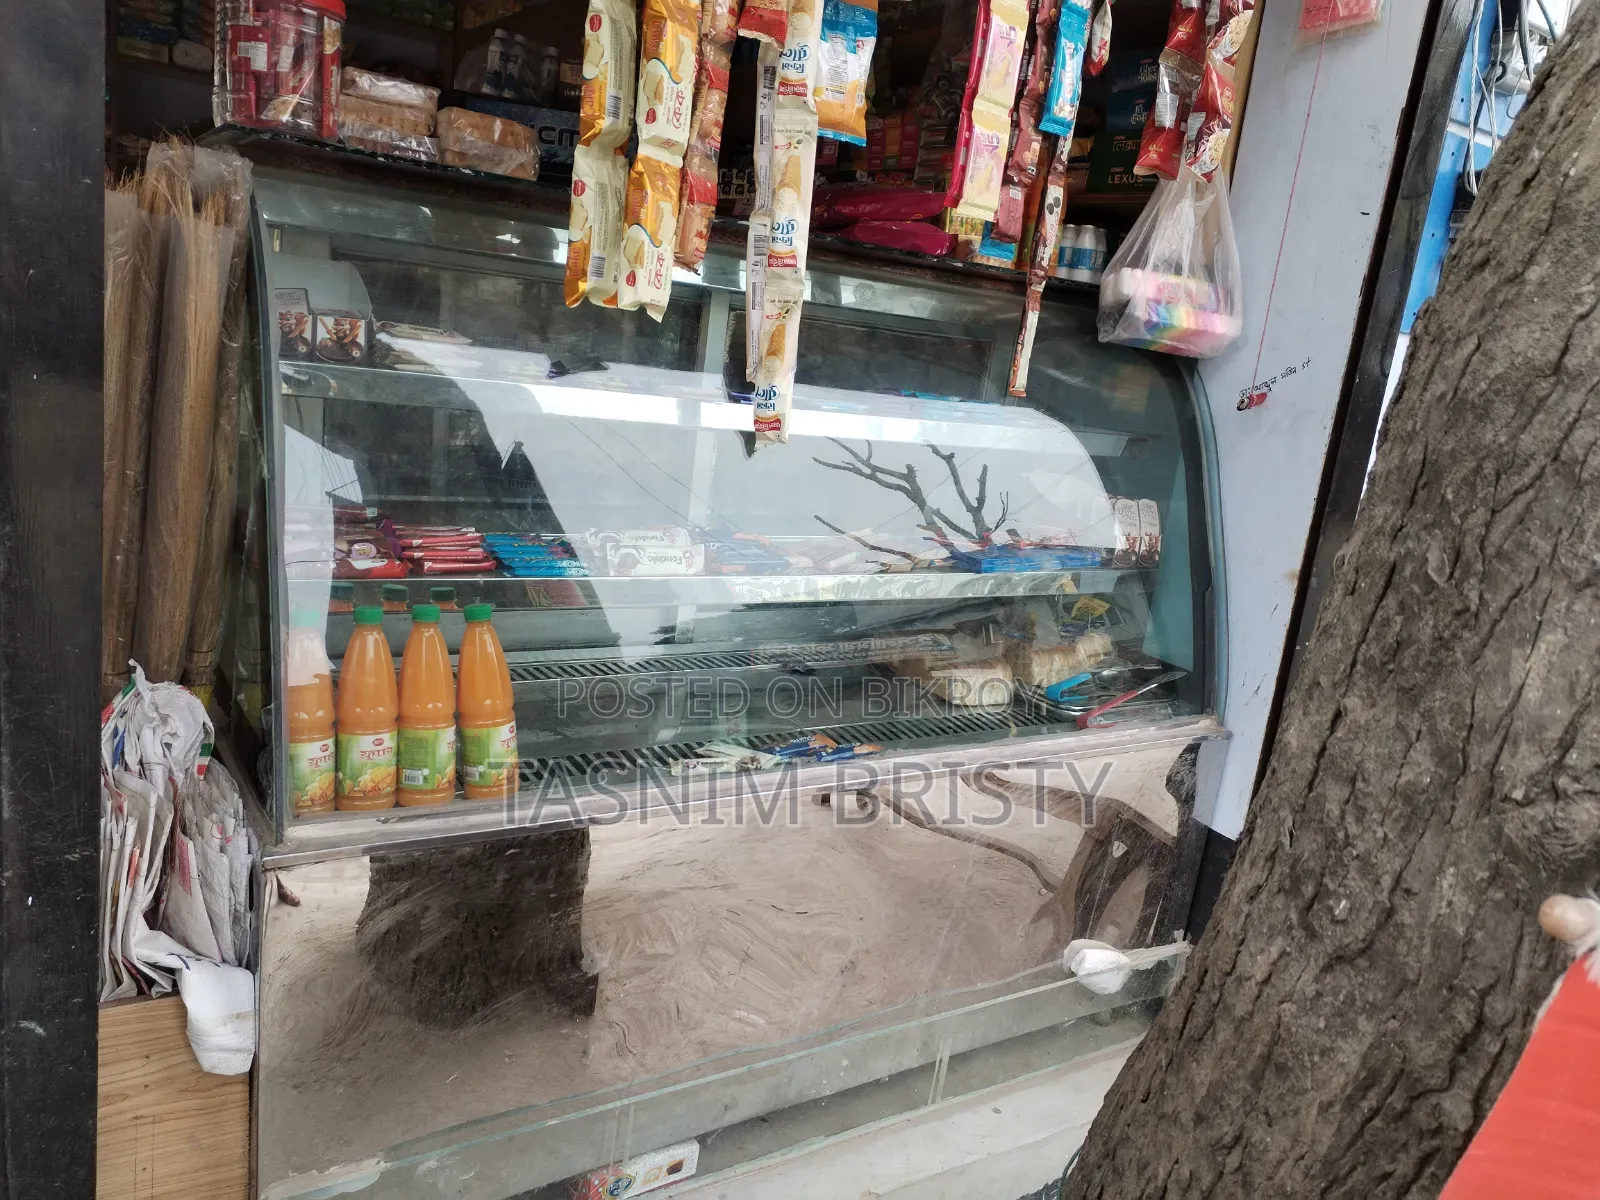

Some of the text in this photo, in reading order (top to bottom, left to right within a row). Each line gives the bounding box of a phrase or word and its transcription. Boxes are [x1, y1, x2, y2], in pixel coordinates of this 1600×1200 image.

[671, 88, 686, 130] কেক
[1108, 173, 1144, 184] LEXUS
[653, 251, 666, 290] কেক
